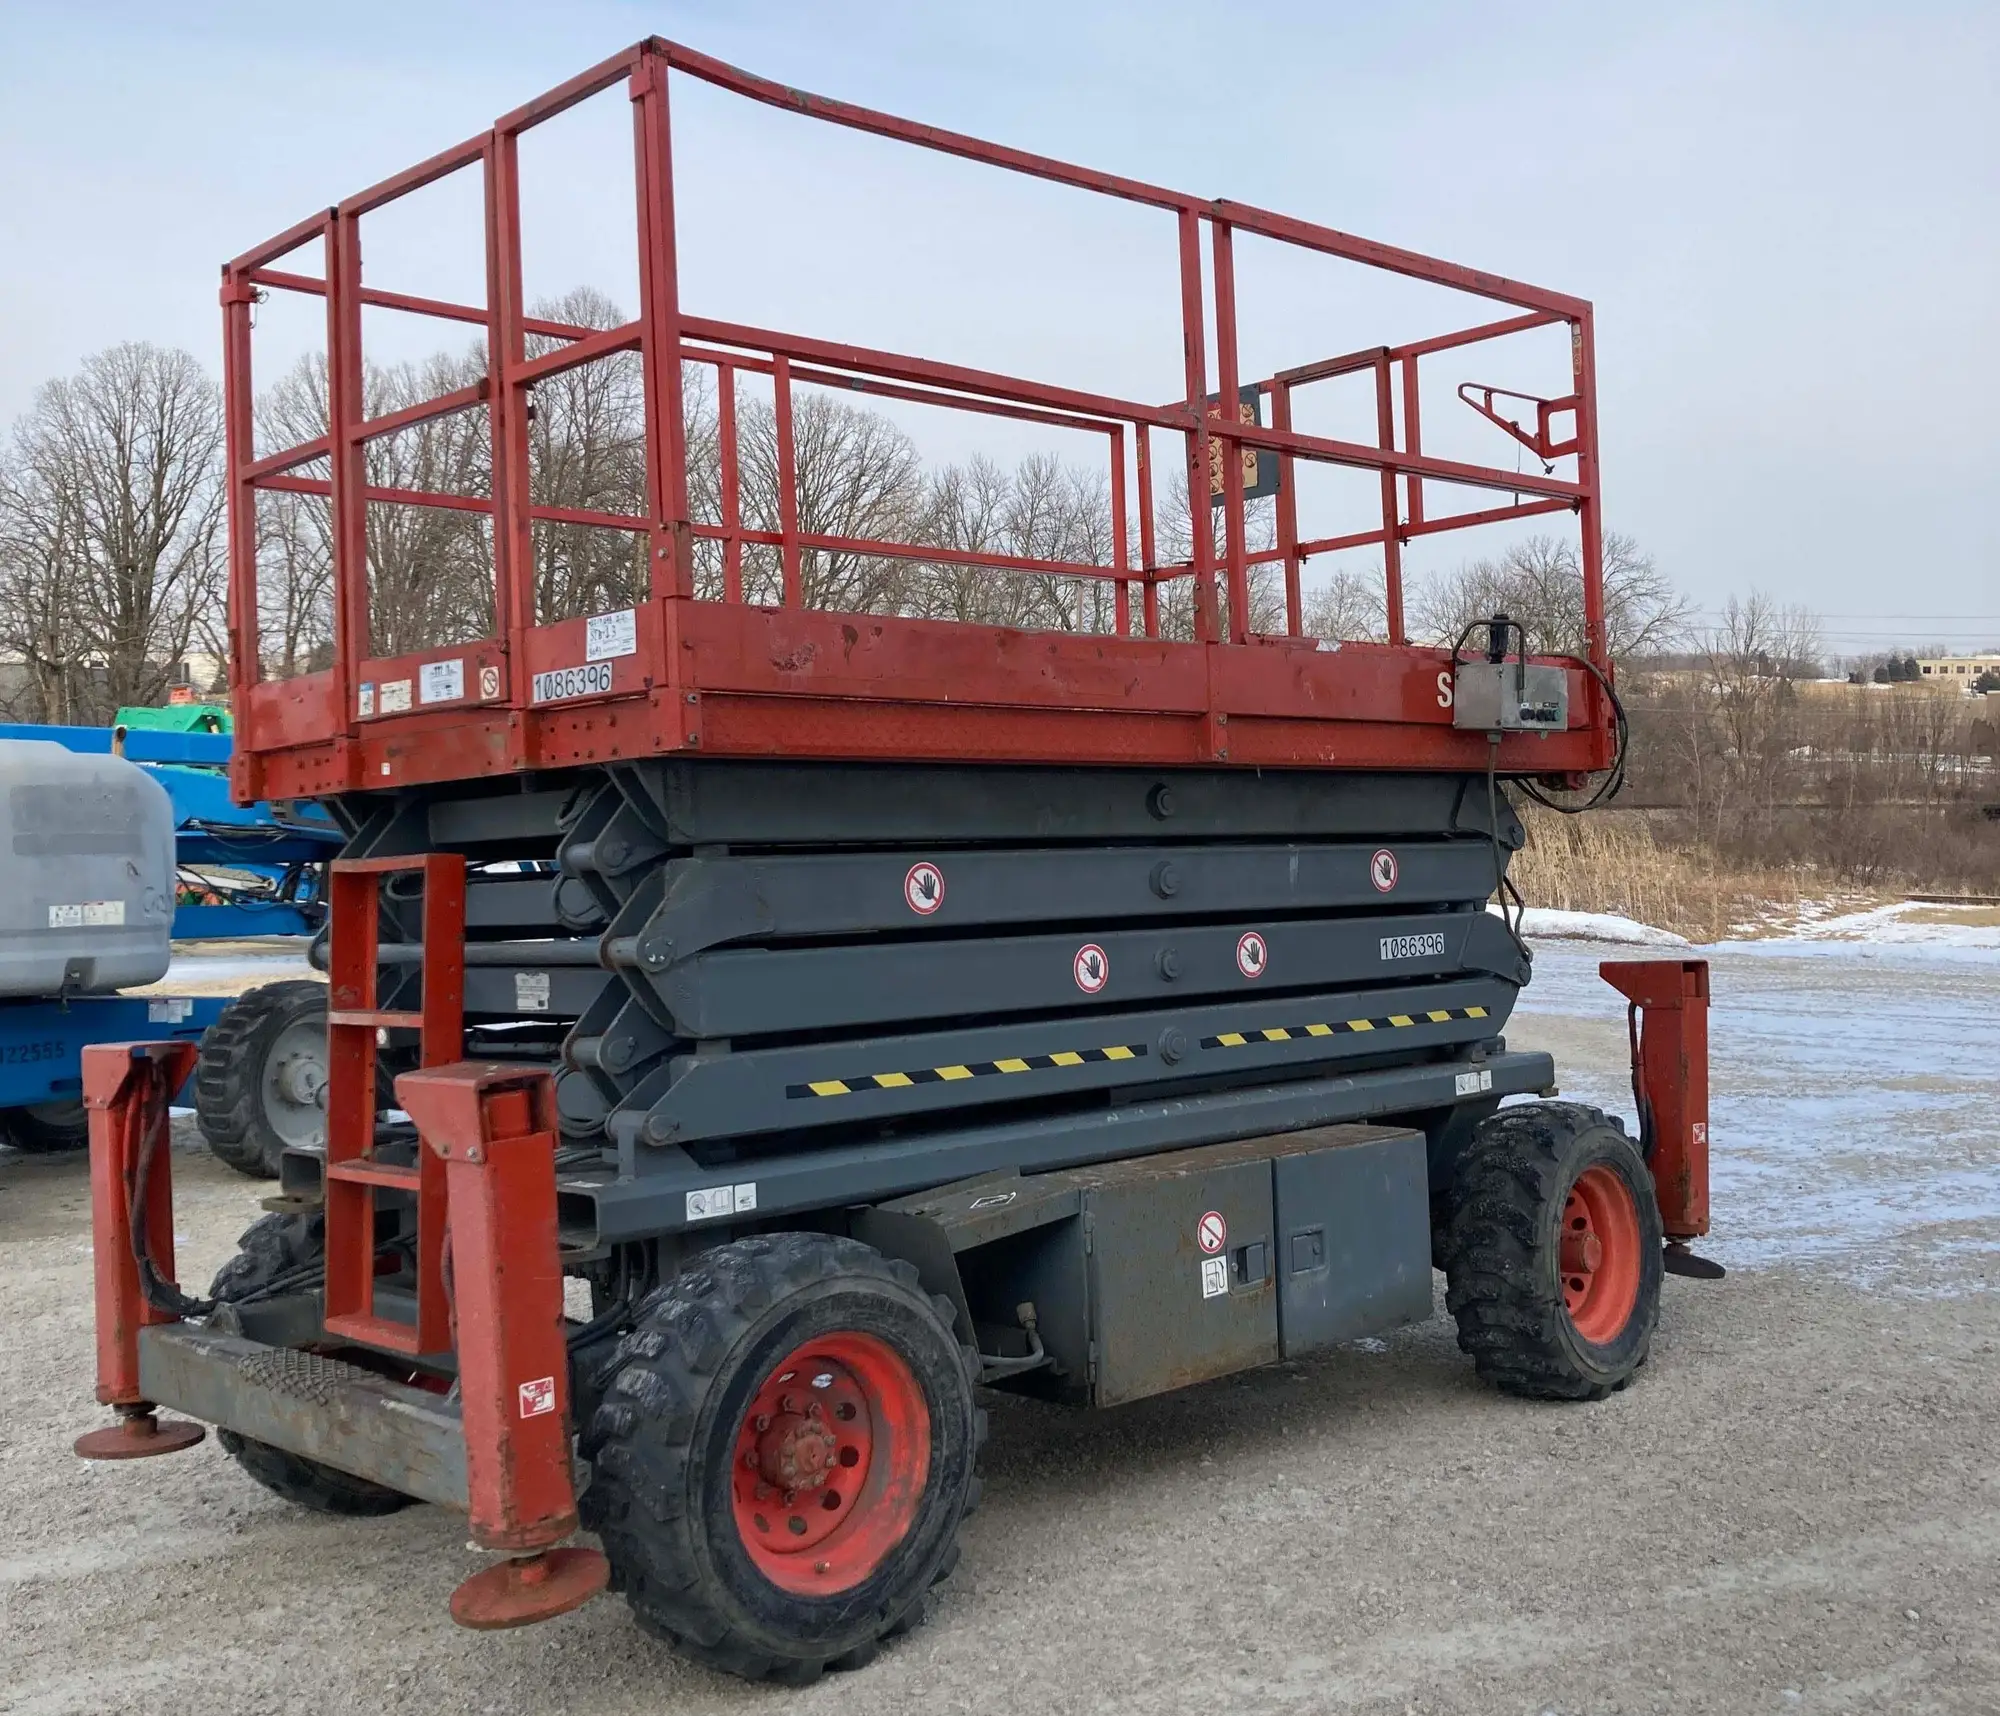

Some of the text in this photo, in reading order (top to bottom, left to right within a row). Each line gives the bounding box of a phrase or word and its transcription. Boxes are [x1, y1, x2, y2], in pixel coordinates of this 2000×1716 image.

[535, 664, 610, 701] 1086396
[1437, 671, 1453, 708] S
[1382, 934, 1443, 959] 1086396
